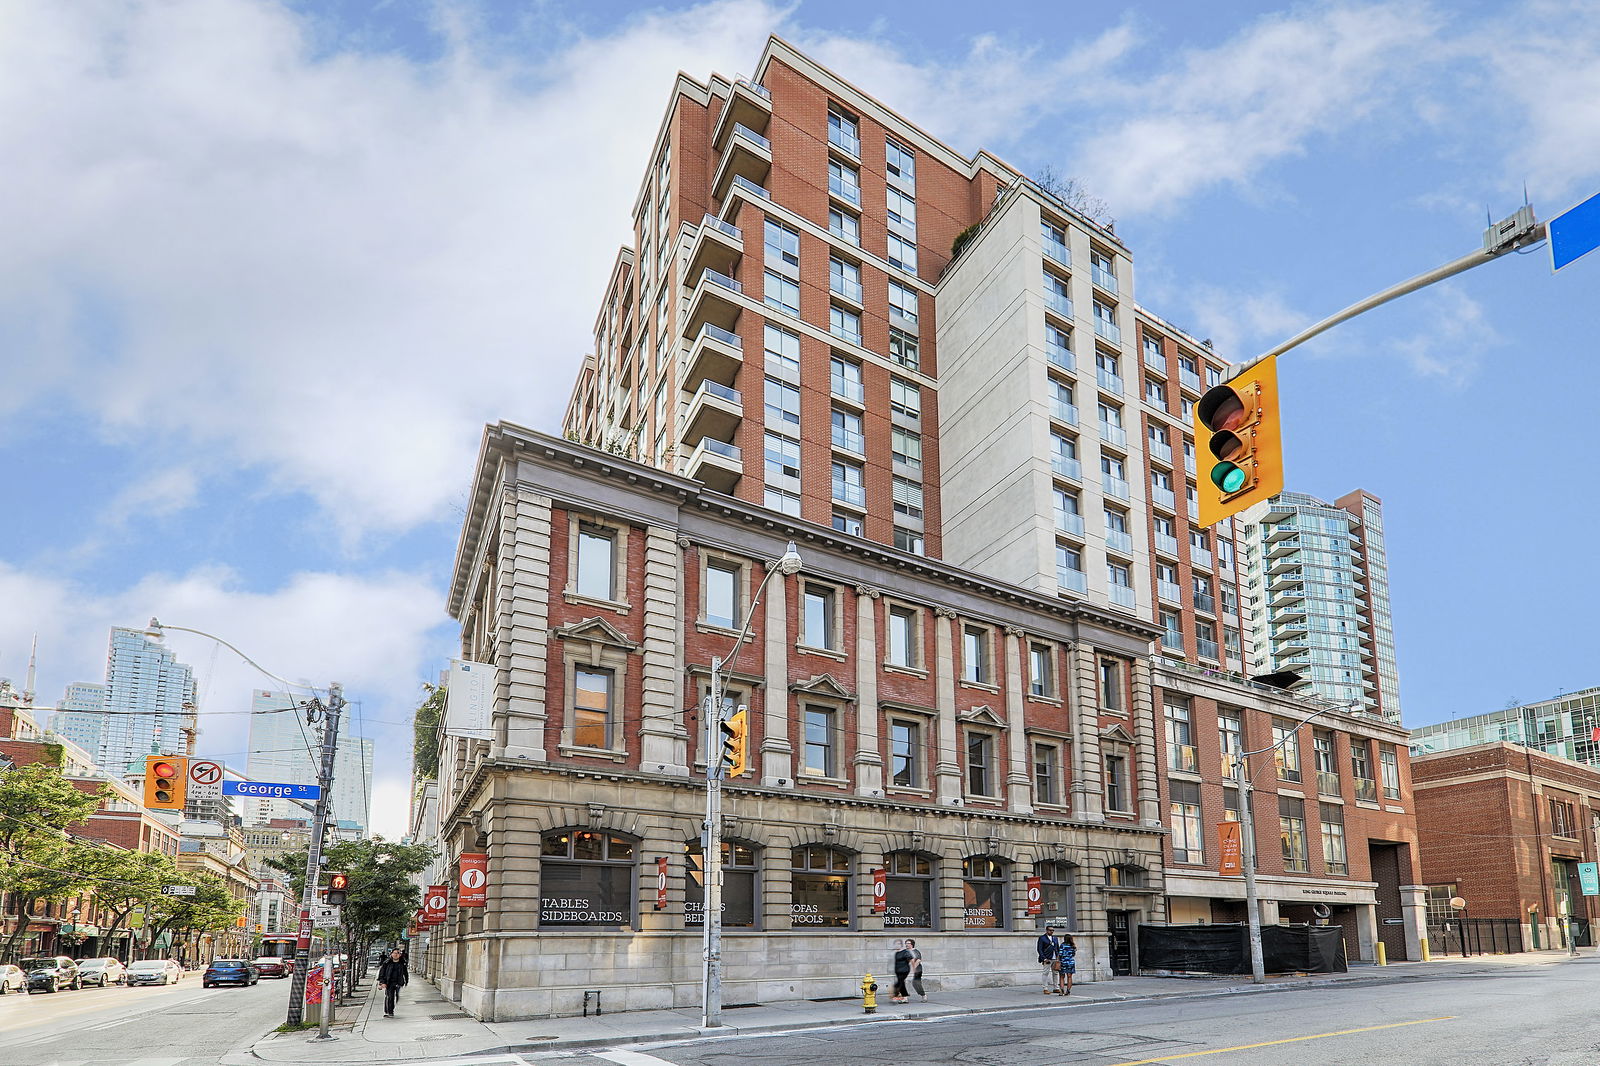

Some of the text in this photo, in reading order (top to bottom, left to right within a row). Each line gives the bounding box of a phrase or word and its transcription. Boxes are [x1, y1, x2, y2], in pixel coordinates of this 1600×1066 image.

[237, 782, 292, 798] George
[542, 898, 589, 909] TABLES
[541, 911, 622, 921] SIDEBOARDS
[963, 908, 993, 917] ABINETS
[684, 913, 705, 923] BED
